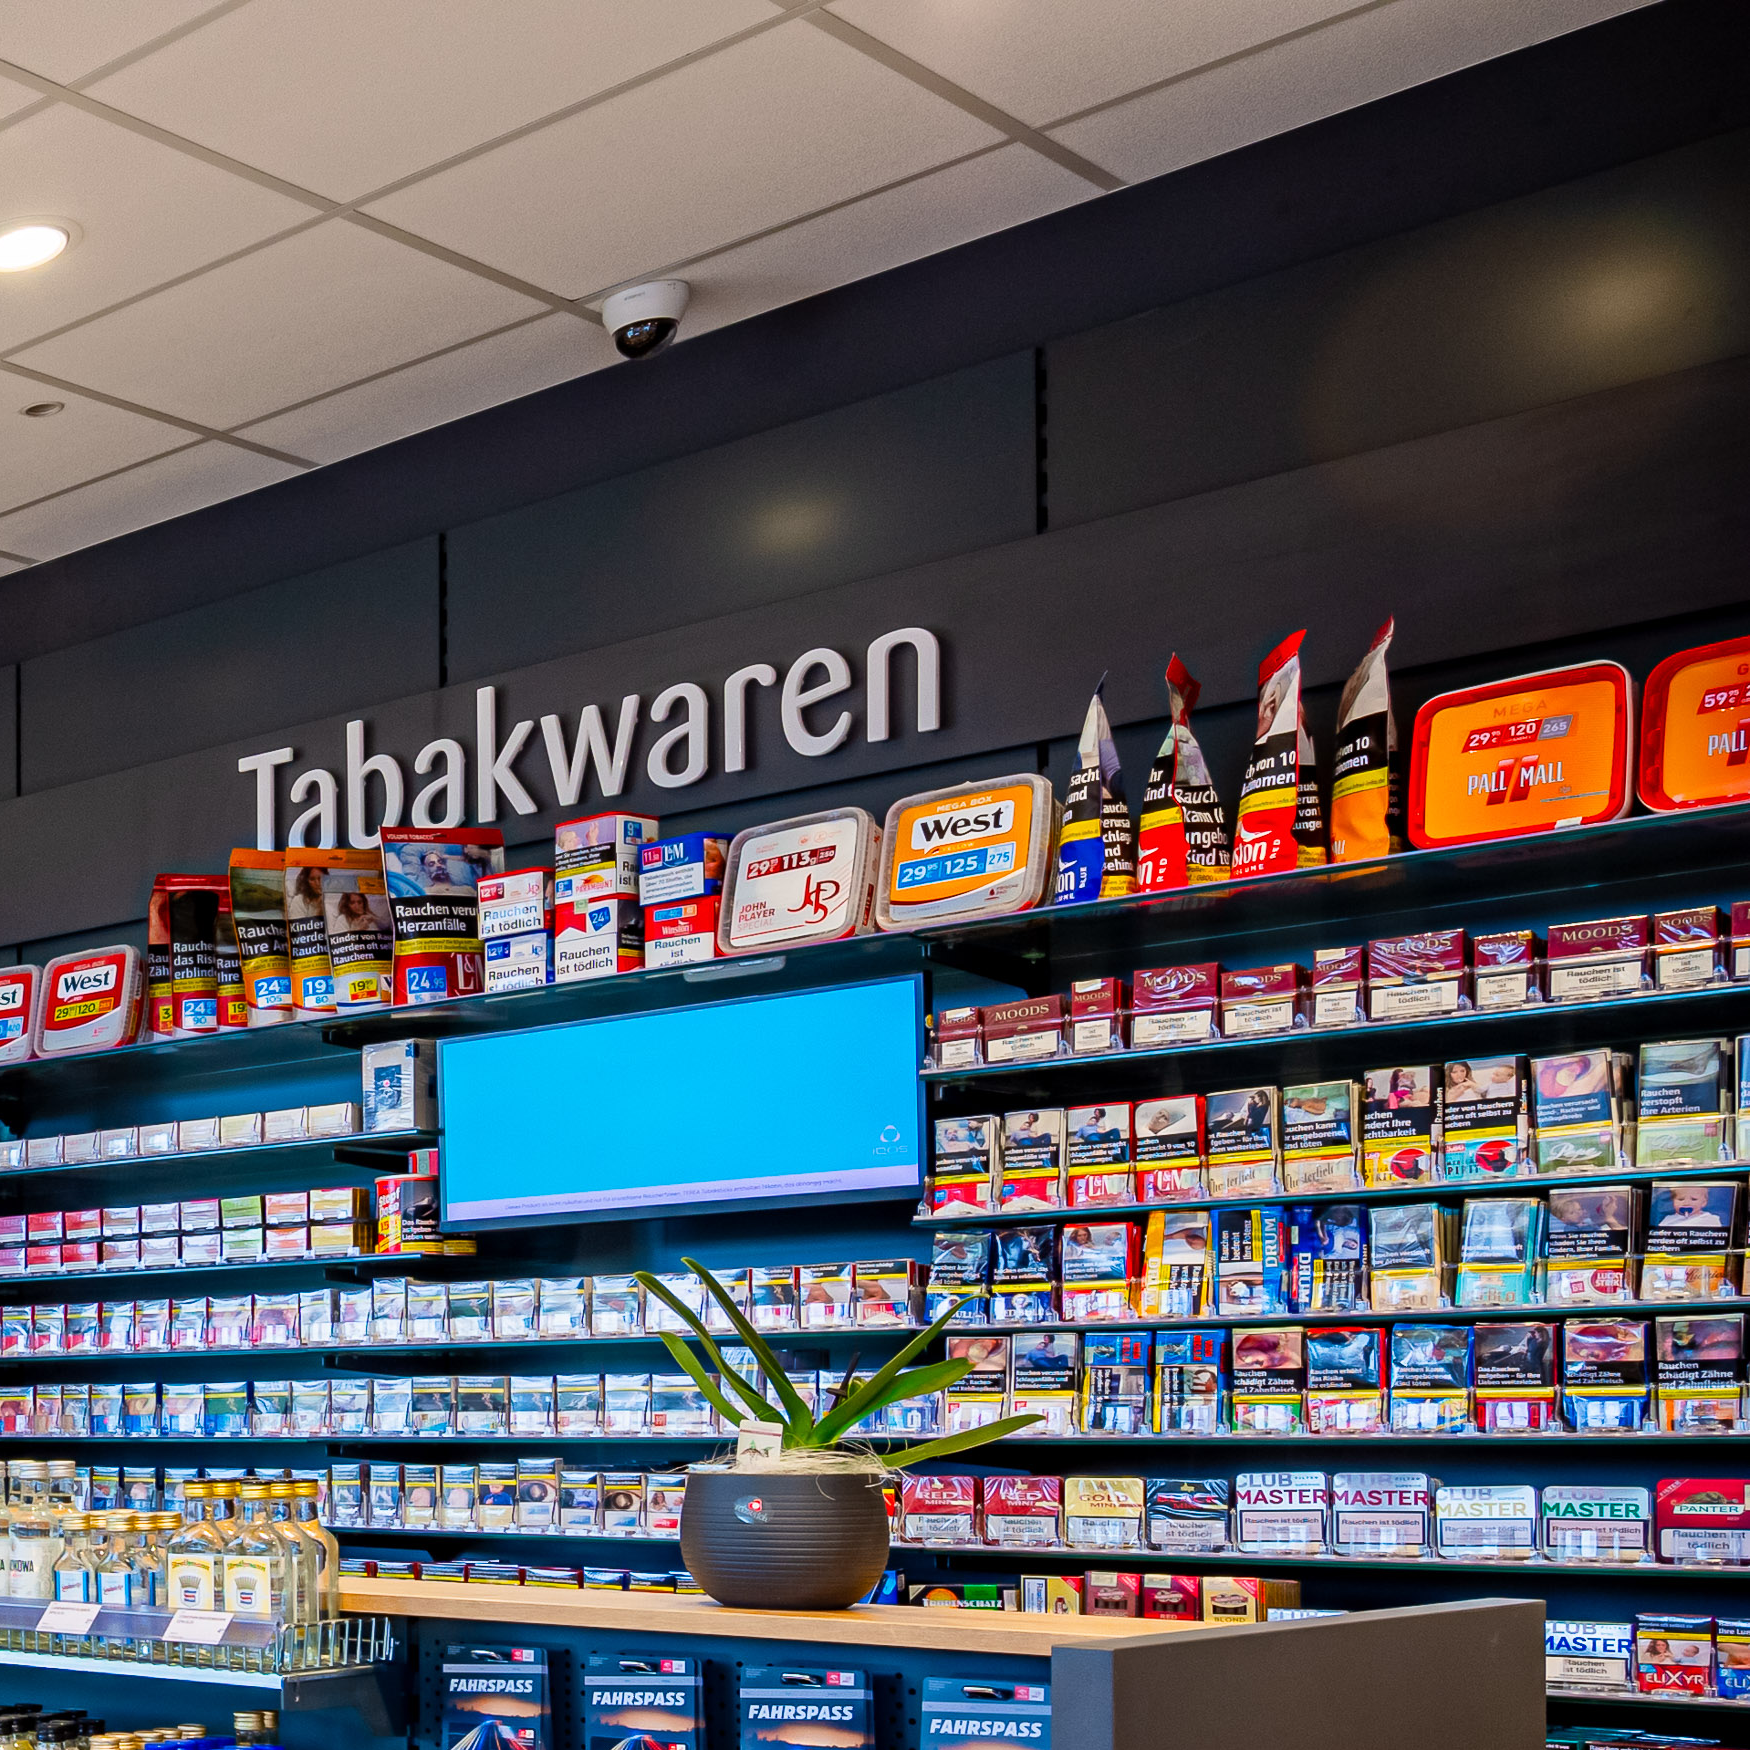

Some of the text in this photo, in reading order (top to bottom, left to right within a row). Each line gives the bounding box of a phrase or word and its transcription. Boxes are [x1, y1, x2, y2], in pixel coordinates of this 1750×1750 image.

[1493, 700, 1548, 718] MEGA
[238, 627, 941, 852] Tabakwaren
[1708, 729, 1747, 756] PALL
[1468, 761, 1564, 795] PALL MALL
[937, 795, 993, 813] MEGA BOX
[920, 807, 1004, 842] West
[576, 879, 612, 893] PARAMOUNT
[396, 904, 450, 918] Rauchen
[484, 904, 538, 921] Rauchen
[741, 902, 766, 913] JOHN
[738, 908, 775, 922] PLAYER
[398, 921, 467, 932] Herzanfälle
[481, 916, 541, 934] ist tödlich
[331, 934, 359, 944] Kinder
[654, 936, 700, 950] Rauchen
[242, 943, 268, 955] Ihre
[332, 941, 377, 954] werden oft
[560, 946, 610, 961] Rauchen
[671, 949, 683, 958] ist
[174, 955, 194, 966] das
[334, 953, 375, 965] Rauchern
[557, 958, 612, 974] ist tödlich
[64, 972, 110, 992] West
[218, 972, 239, 982] Ihre
[1579, 974, 1612, 983] tödlich
[1075, 991, 1111, 1002] MOODS
[995, 1004, 1049, 1020] MOODS
[1640, 1097, 1683, 1106] verstopft
[1661, 1105, 1700, 1114] Arterien
[1265, 1218, 1276, 1268] DRUM
[1079, 1494, 1129, 1502] GOLD
[1236, 1490, 1328, 1506] MASTER
[1334, 1490, 1427, 1506] MASTER
[1680, 1505, 1738, 1514] PANTER
[450, 1679, 533, 1693] FAHRSPASS
[592, 1692, 685, 1706] FAHRSPASS
[749, 1705, 853, 1721] FAHRSPASS
[930, 1719, 1042, 1738] FAHRSPASS
